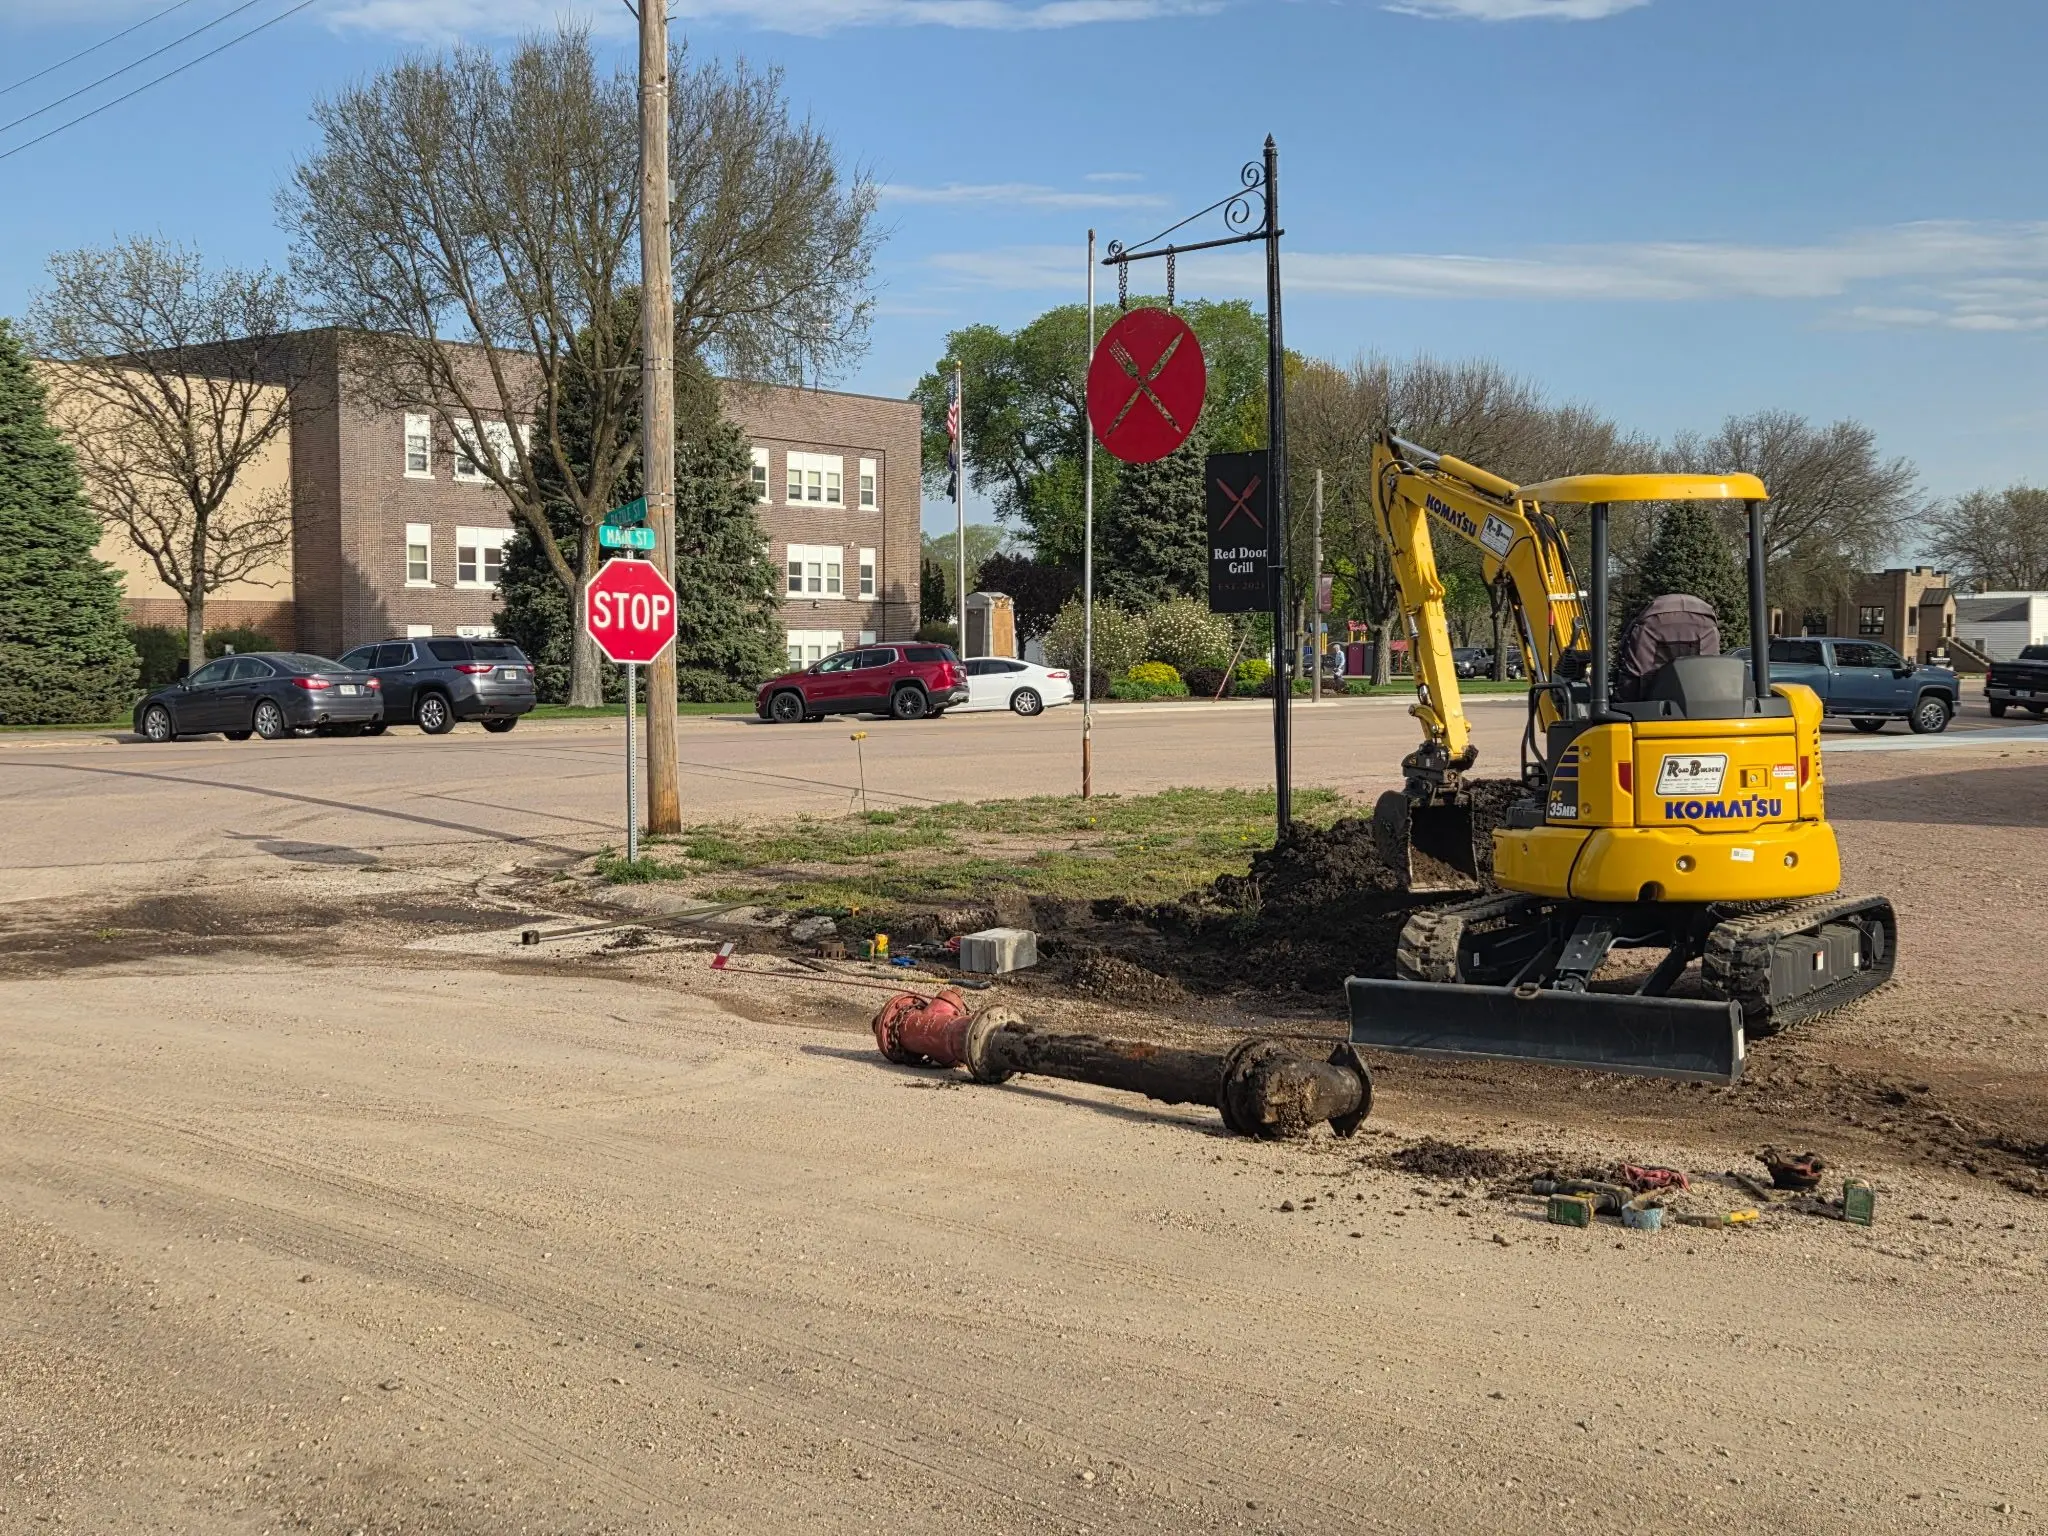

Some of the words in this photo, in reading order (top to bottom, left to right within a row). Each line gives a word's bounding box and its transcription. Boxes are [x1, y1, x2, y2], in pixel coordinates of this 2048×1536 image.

[1425, 493, 1477, 537] KOMATSU
[607, 529, 631, 545] MAIN
[636, 530, 647, 546] ST
[1214, 548, 1236, 560] Red
[1239, 547, 1267, 559] Door
[1229, 561, 1253, 574] Grill
[592, 590, 670, 631] STOP
[1551, 790, 1563, 801] PC
[1550, 802, 1577, 817] 35MR
[1665, 794, 1782, 819] KOMATSU
